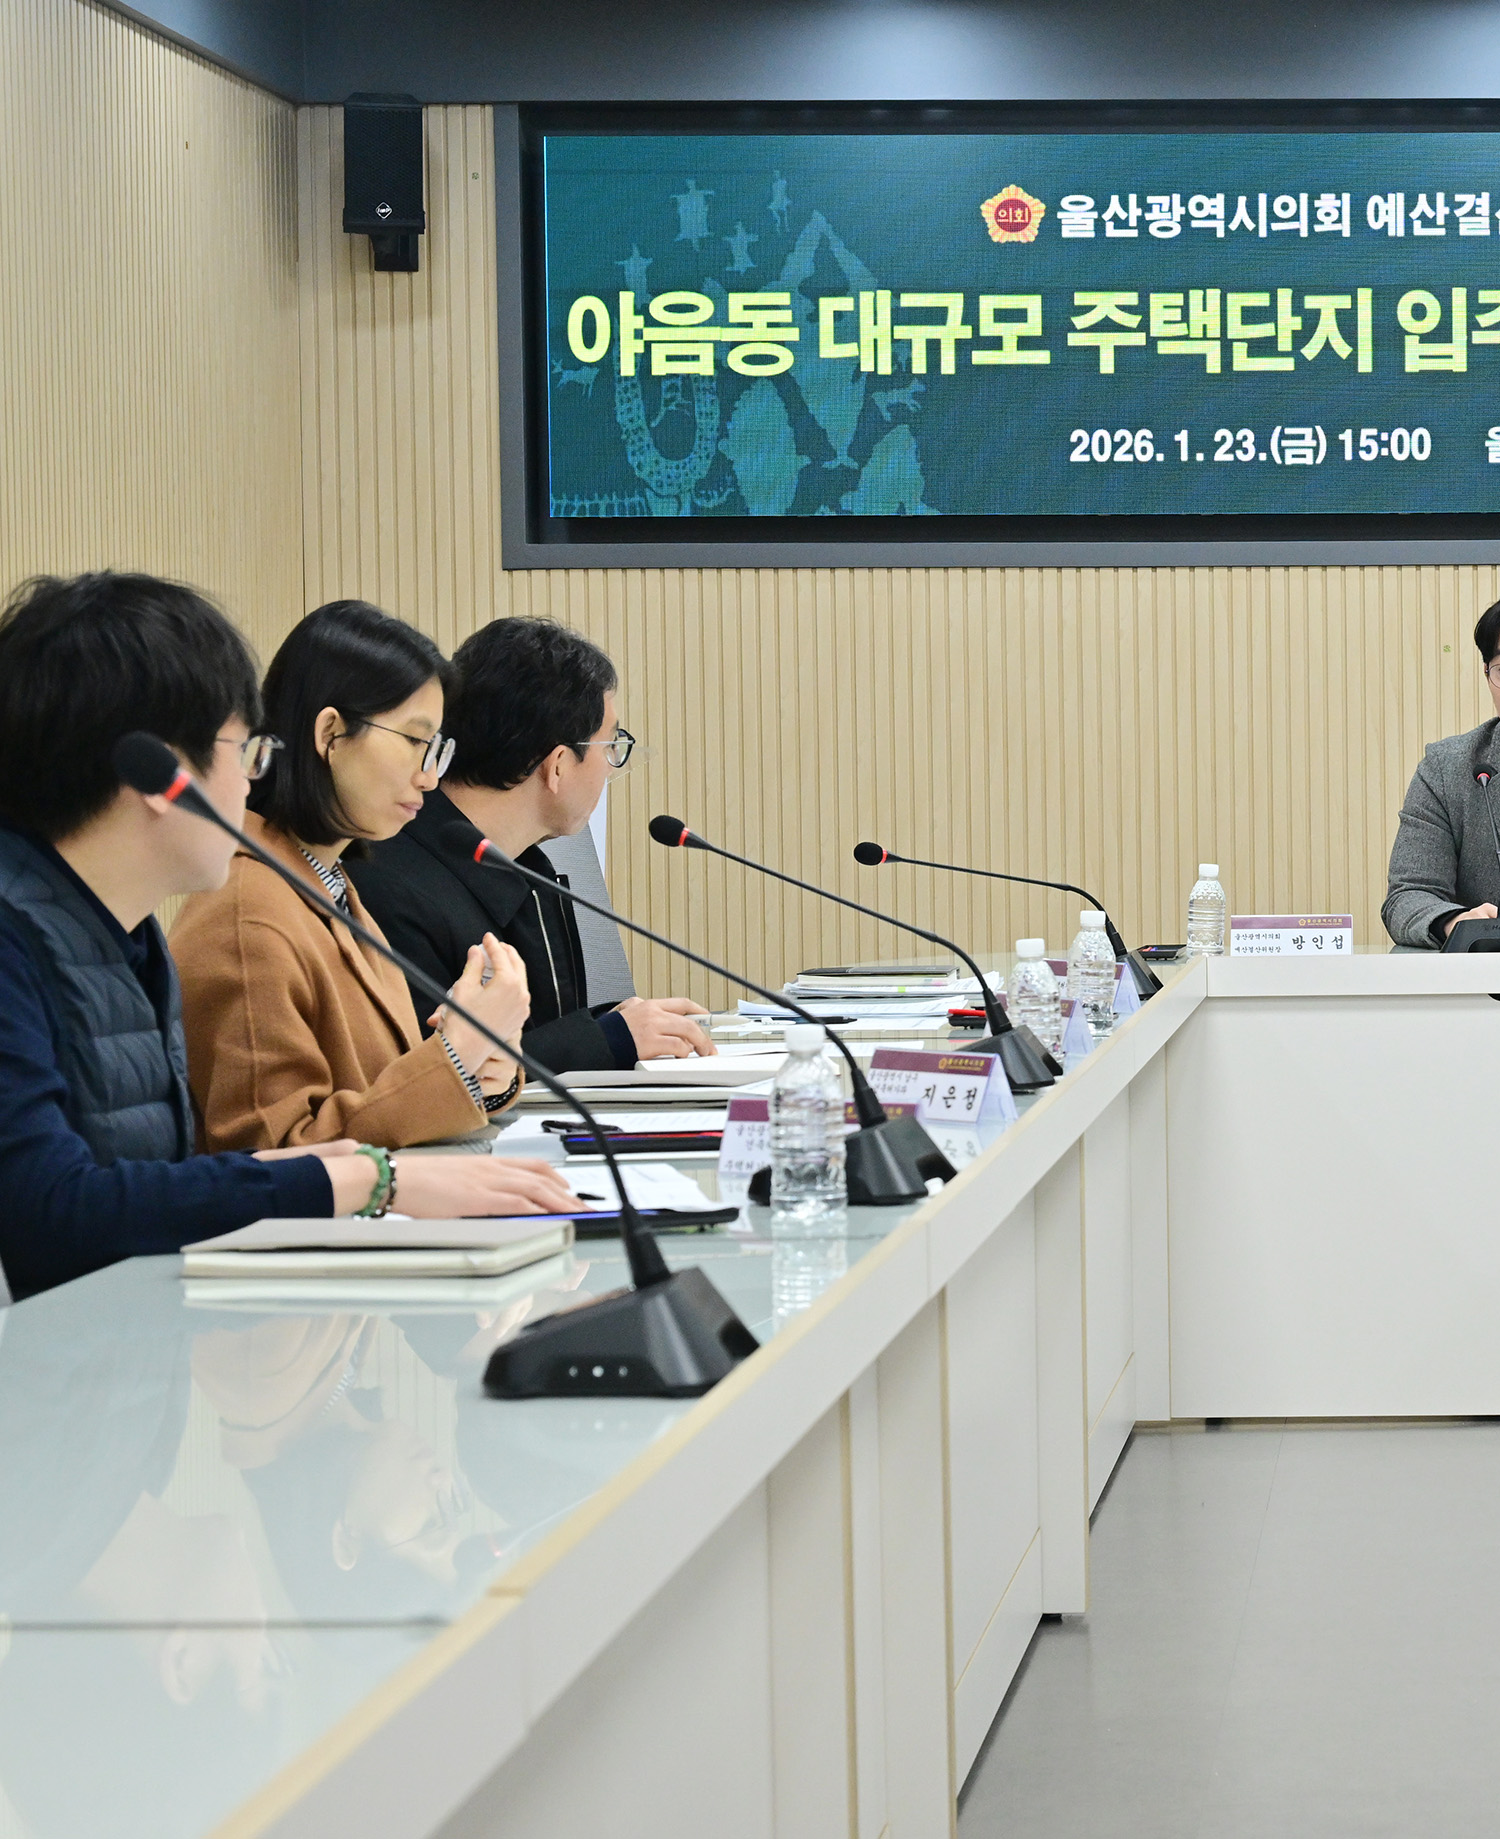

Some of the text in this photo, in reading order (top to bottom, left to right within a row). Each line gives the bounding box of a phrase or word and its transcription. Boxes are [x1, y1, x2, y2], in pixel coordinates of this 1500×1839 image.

[997, 207, 1030, 223] 의회
[1056, 192, 1351, 239] 울산광역시의회
[567, 290, 800, 377] 야음동
[818, 289, 1051, 375] 대규모
[1067, 287, 1373, 374] 주택단지
[1069, 425, 1432, 465] 2026. 1. 23.(금) 15:00
